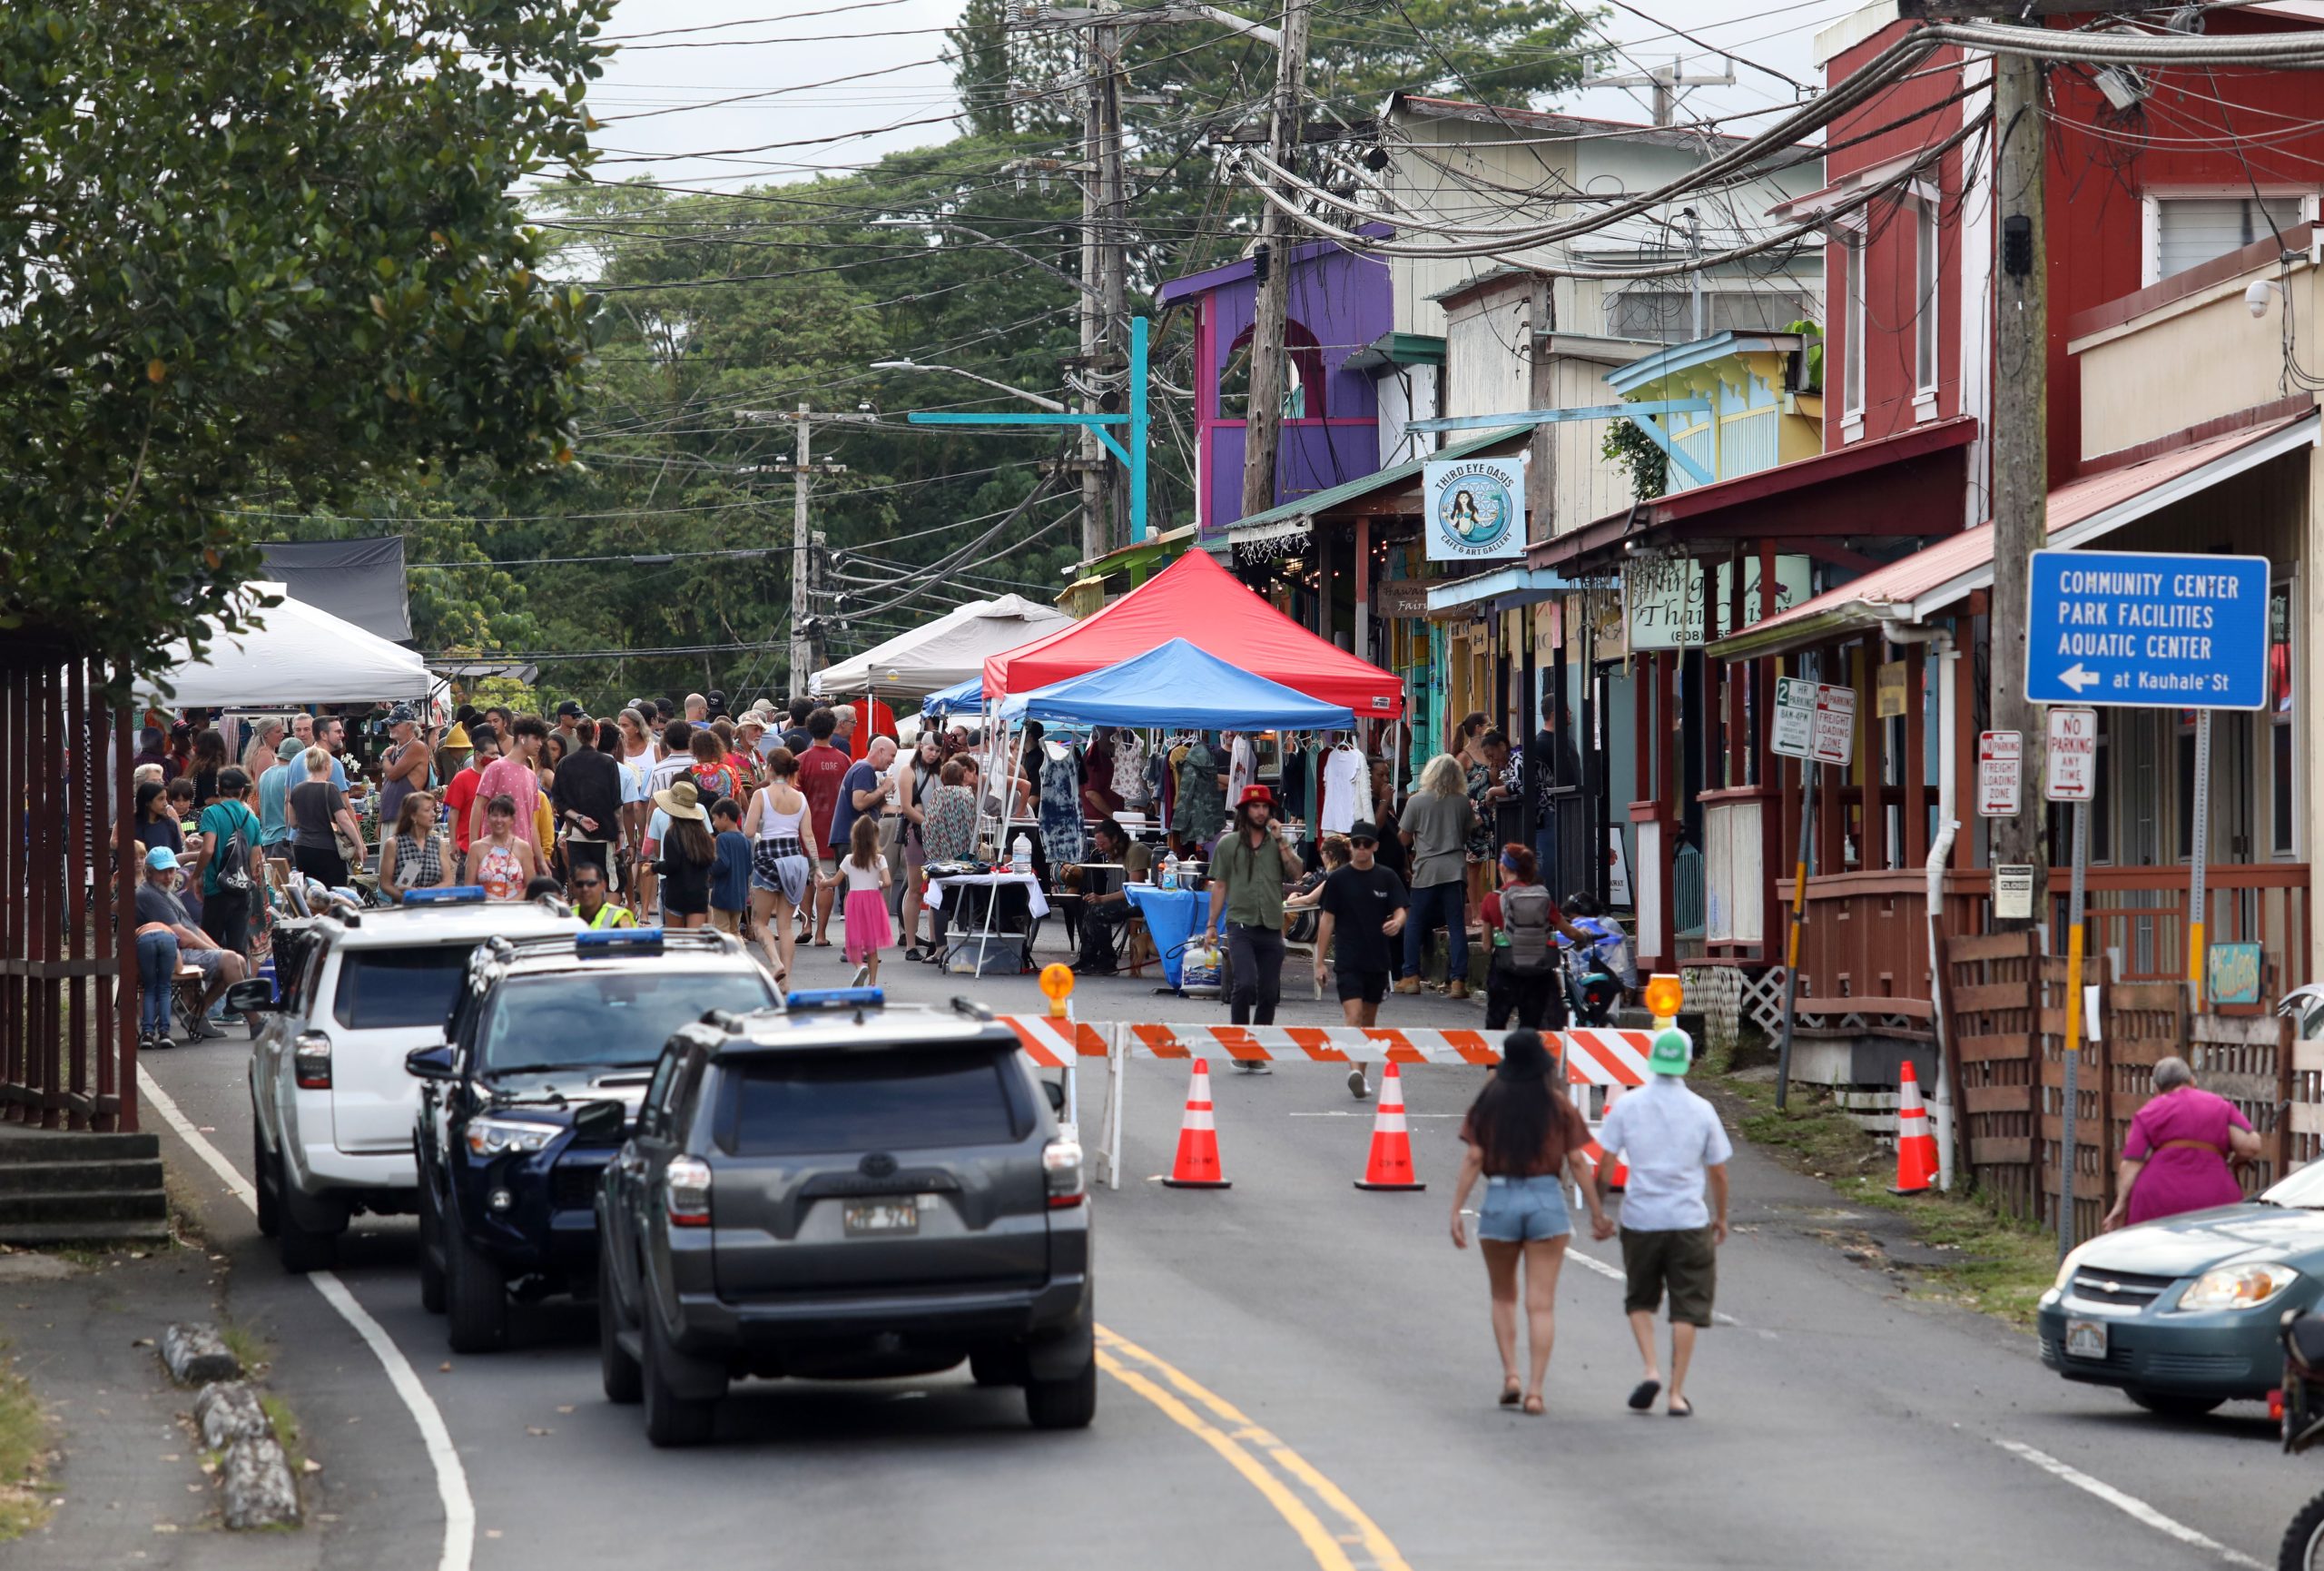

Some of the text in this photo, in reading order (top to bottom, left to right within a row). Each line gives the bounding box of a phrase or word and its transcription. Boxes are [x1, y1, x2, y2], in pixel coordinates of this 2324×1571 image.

[1435, 463, 1514, 490] THIRD EYE OASIS
[1441, 535, 1458, 550] CAFE
[1482, 532, 1512, 554] GALLERY
[2059, 570, 2239, 598] COMMUNITY CENTER
[2058, 601, 2213, 628] PARK FACILITIES
[2057, 633, 2211, 659] AQUATIC CENTER
[2112, 671, 2230, 691] at Kauhale St
[1778, 683, 1808, 702] 2 HR
[1789, 696, 1814, 708] PARKING
[1829, 696, 1854, 707] PARKING
[1819, 713, 1849, 726] FREIGHT
[1817, 725, 1849, 738] LOADING
[2063, 718, 2081, 736] NO
[1823, 736, 1842, 749] ZONE
[1994, 741, 2019, 752] PARKING
[2052, 737, 2092, 755] PARKING
[2063, 756, 2081, 766] ANY
[1984, 763, 2015, 773] FREIGHT
[1984, 776, 2016, 786] LOADING
[2060, 769, 2082, 781] TIME
[1989, 788, 2010, 798] ZONE
